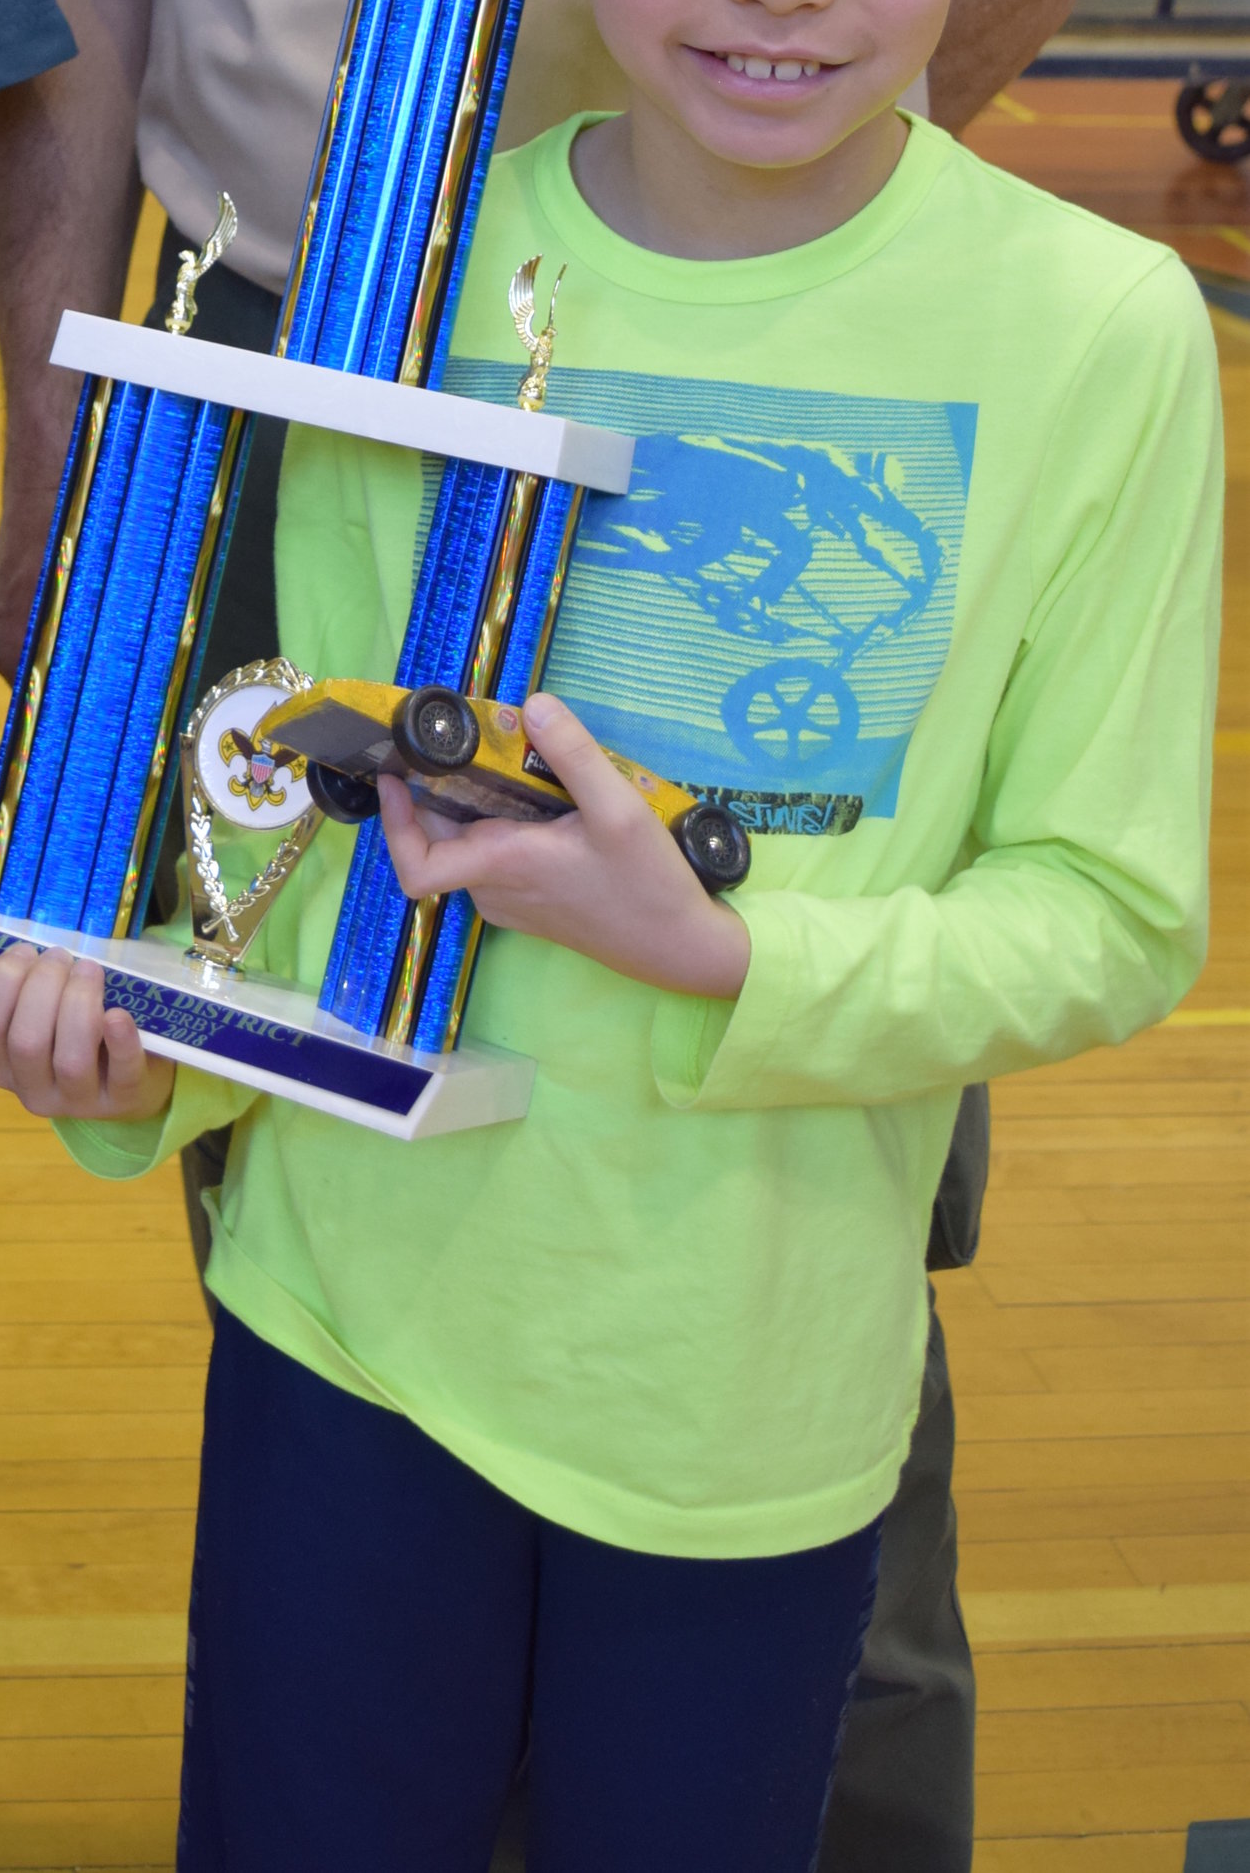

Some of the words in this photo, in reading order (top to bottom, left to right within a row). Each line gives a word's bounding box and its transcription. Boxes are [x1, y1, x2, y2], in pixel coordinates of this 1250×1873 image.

[151, 1004, 224, 1037] DERBY
[160, 1023, 208, 1047] 2018
[171, 989, 311, 1048] DISTRICT
